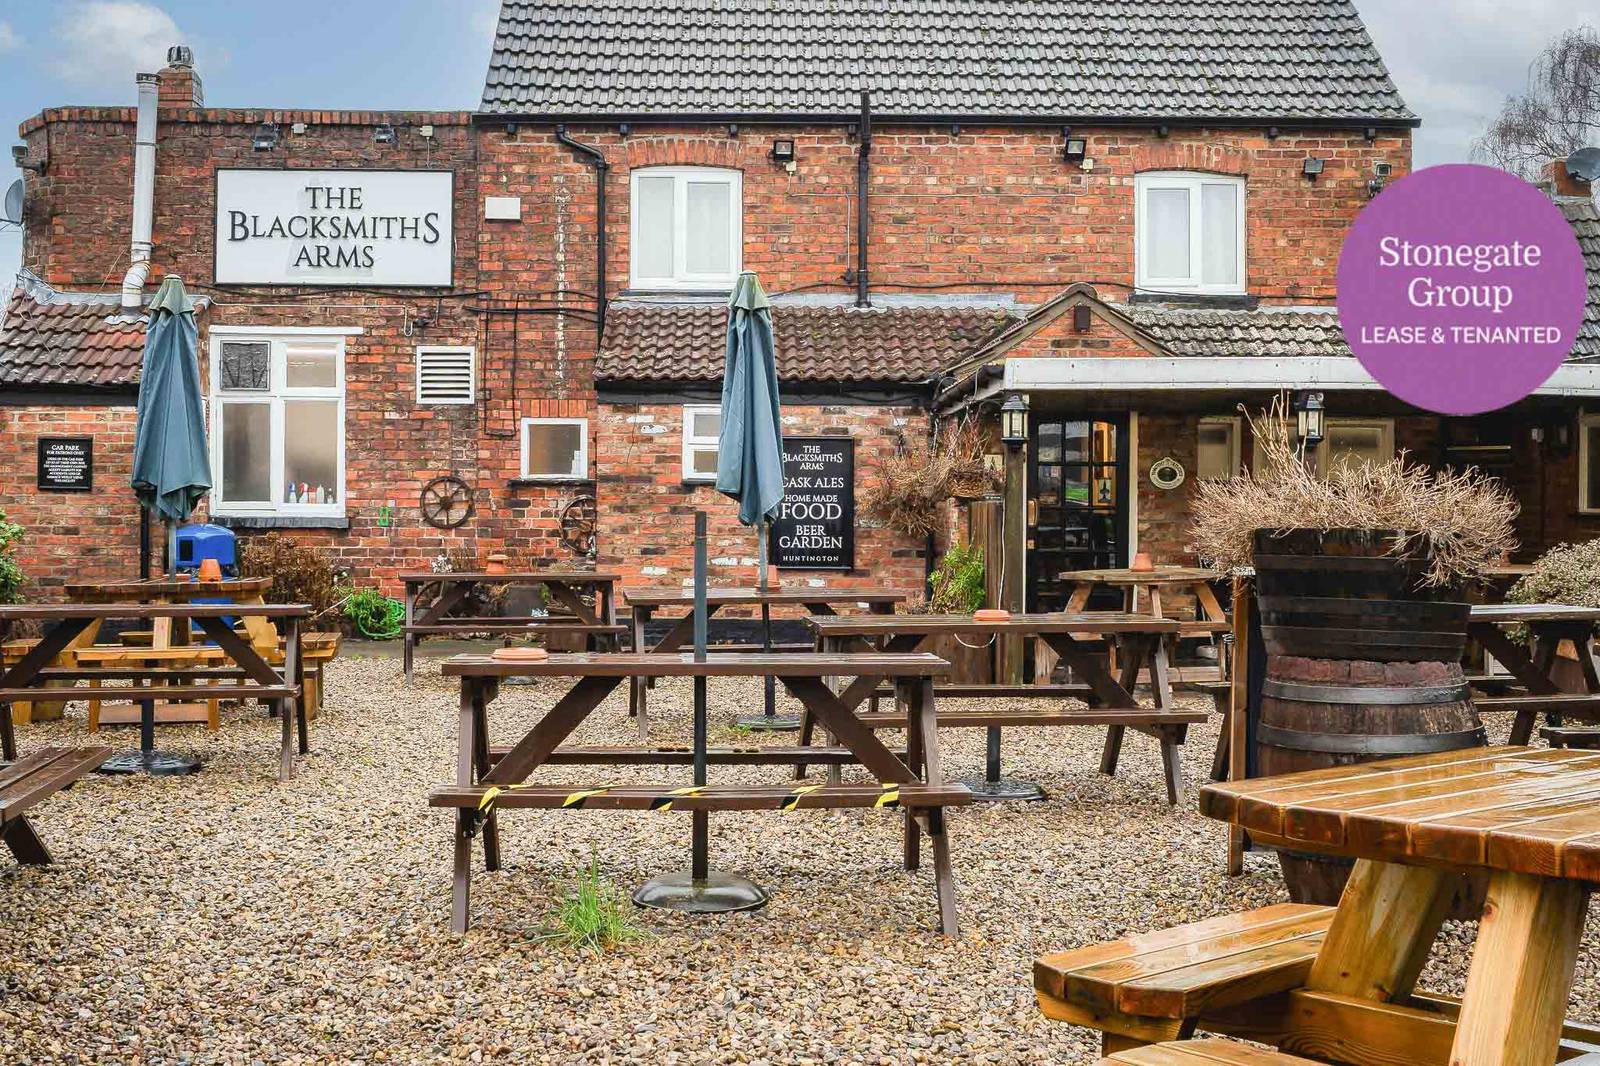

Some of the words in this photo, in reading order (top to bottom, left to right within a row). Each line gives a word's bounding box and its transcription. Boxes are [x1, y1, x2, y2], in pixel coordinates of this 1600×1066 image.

[304, 186, 363, 210] THE
[227, 209, 440, 244] BLACKSMITHS
[292, 245, 375, 269] ARMS
[802, 445, 821, 453] THE
[799, 462, 825, 471] ARMS
[814, 477, 845, 489] ALES
[785, 494, 811, 503] HOME
[813, 494, 839, 503] MADE
[780, 502, 843, 520] FOOD
[796, 524, 827, 537] BEER
[779, 536, 844, 550] GARDEN
